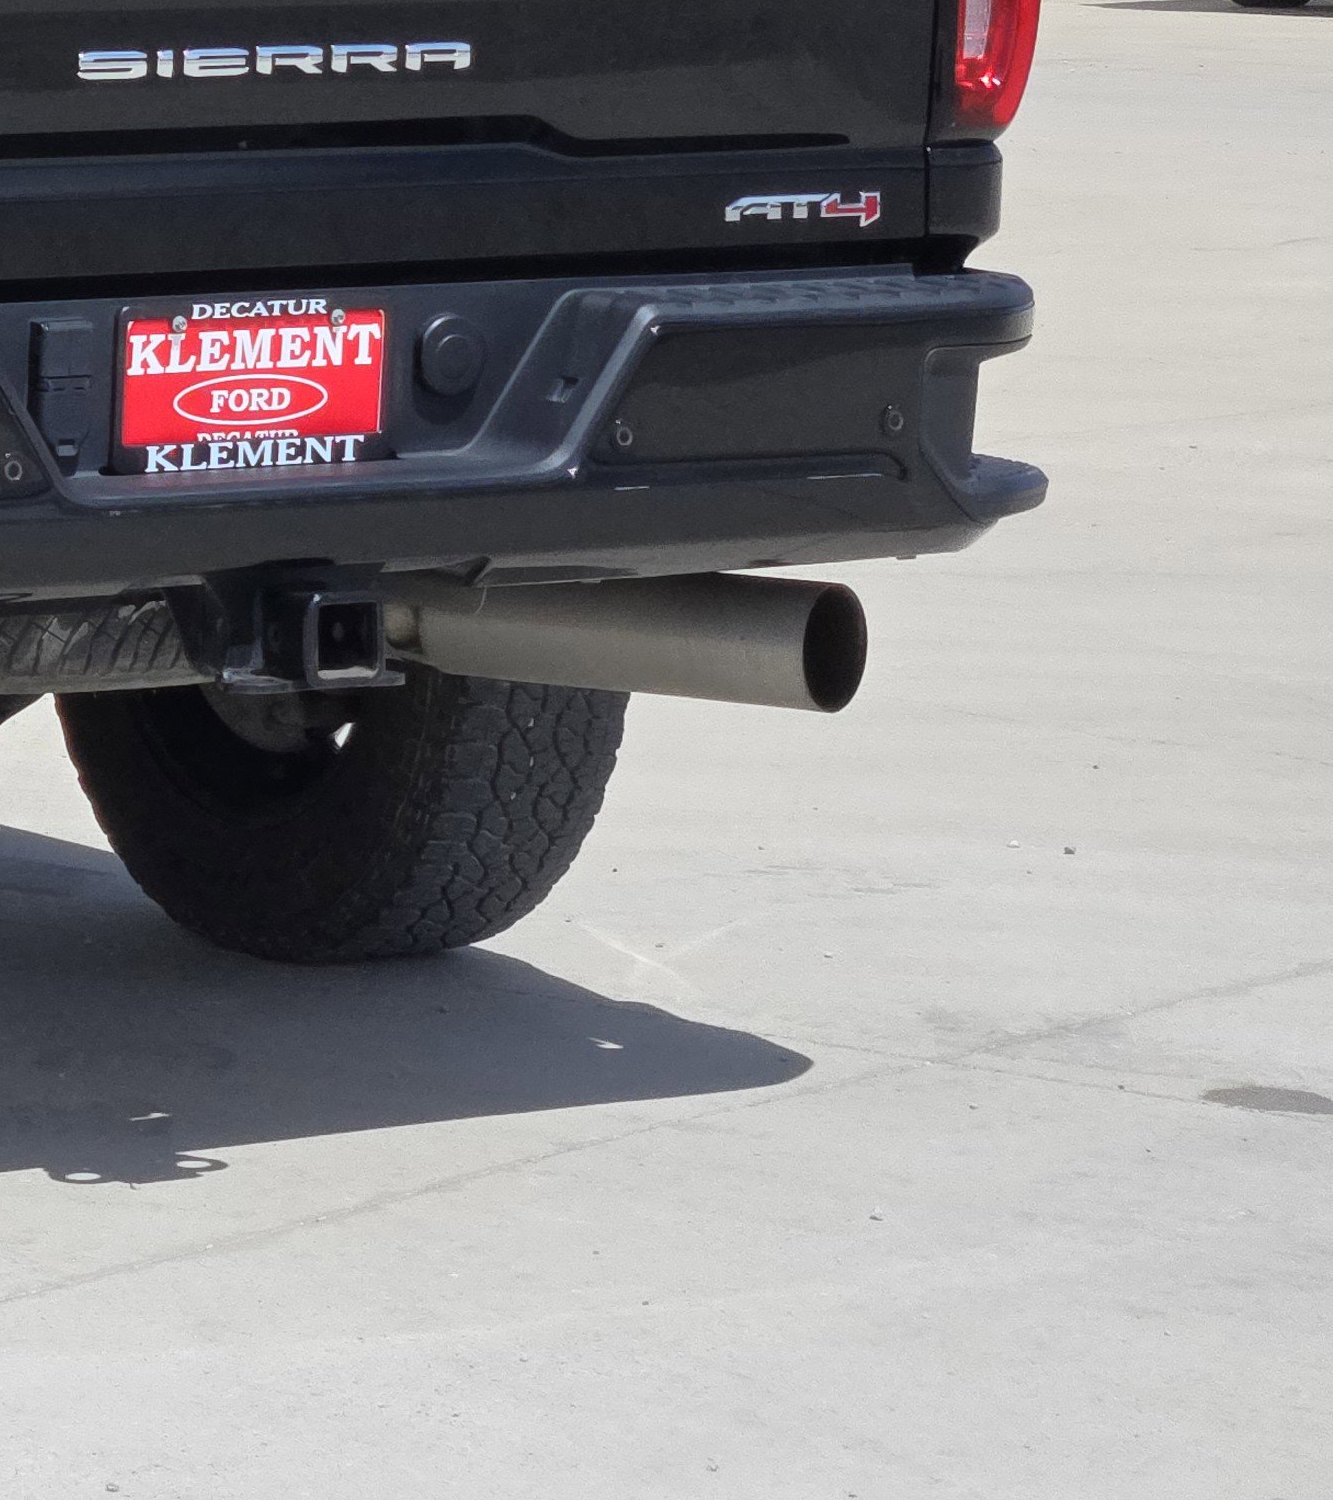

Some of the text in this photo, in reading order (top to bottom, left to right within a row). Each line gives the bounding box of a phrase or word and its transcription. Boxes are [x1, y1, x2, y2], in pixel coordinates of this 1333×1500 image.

[77, 41, 472, 81] SIERRA
[725, 191, 881, 228] AT4
[191, 299, 328, 320] DECATUR
[126, 323, 382, 376] KLEMENT
[209, 387, 292, 414] FORD
[144, 434, 365, 474] KLEMENT
